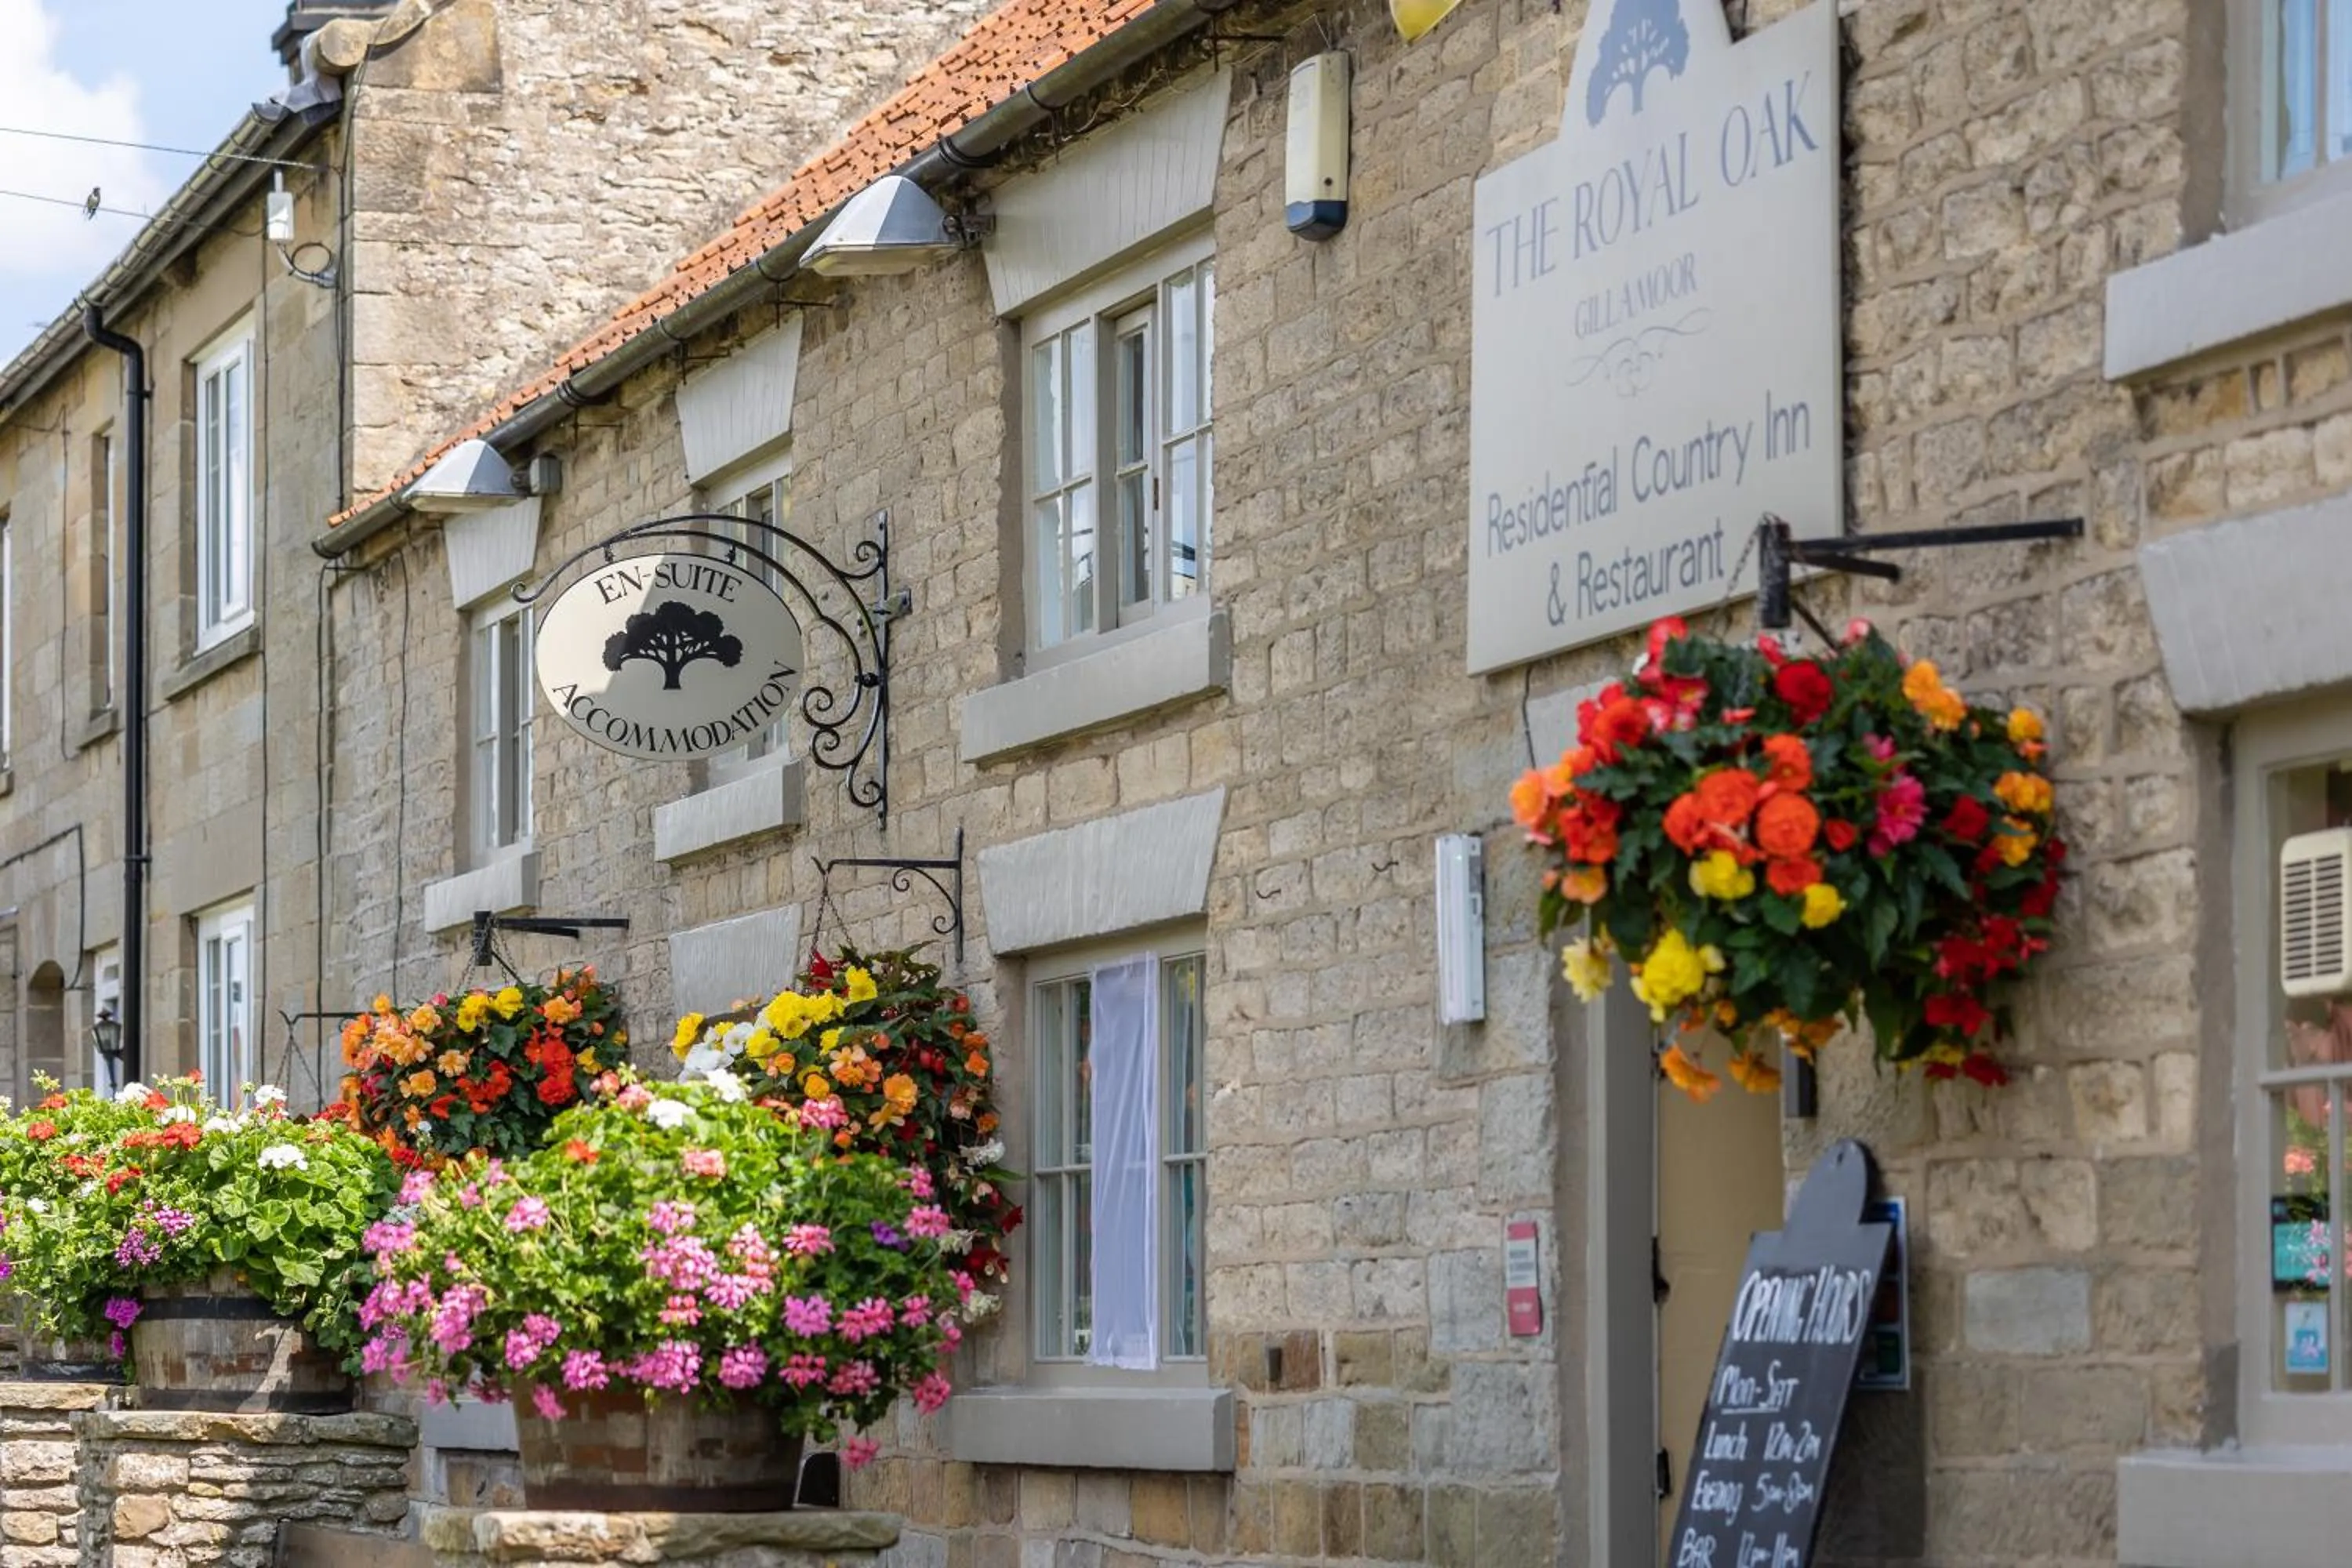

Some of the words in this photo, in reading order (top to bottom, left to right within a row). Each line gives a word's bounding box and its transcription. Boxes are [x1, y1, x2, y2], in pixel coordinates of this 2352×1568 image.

[1486, 197, 1559, 298] THE
[1573, 132, 1700, 260] ROYAL
[1720, 70, 1818, 187] OAK
[1574, 252, 1698, 339] GILLAMOOR
[1487, 445, 1618, 557] Residential
[1632, 419, 1755, 503] Country
[1766, 389, 1810, 461] Inn
[593, 562, 743, 604] EN-SUITE
[1547, 561, 1566, 626] &
[1577, 517, 1724, 619] Restaurant
[552, 660, 797, 754] ACCOMMODATION
